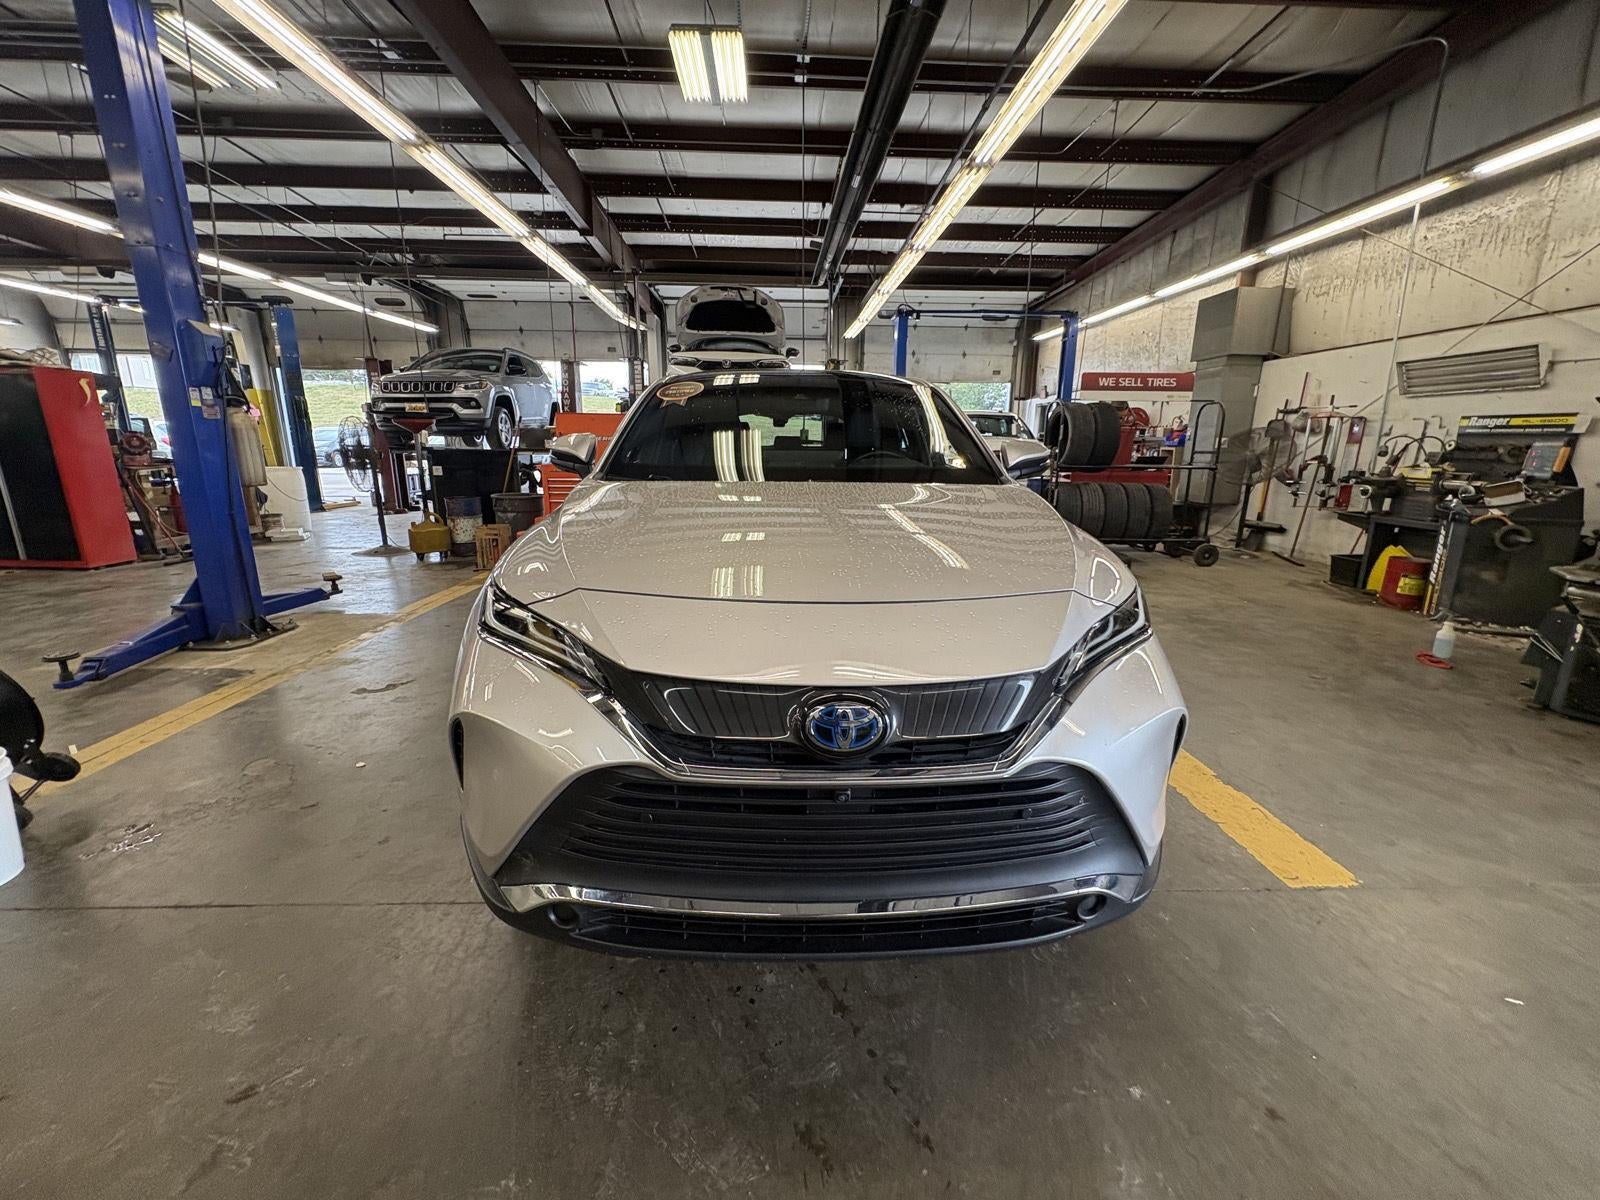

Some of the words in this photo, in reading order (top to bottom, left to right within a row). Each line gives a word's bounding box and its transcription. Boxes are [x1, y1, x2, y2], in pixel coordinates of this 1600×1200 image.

[562, 373, 571, 412] MOHAWK
[1098, 377, 1116, 386] WE
[1118, 378, 1144, 387] SELL
[1147, 378, 1177, 387] TIRES
[1468, 416, 1511, 428] Ranger
[1429, 525, 1447, 585] Ranger
